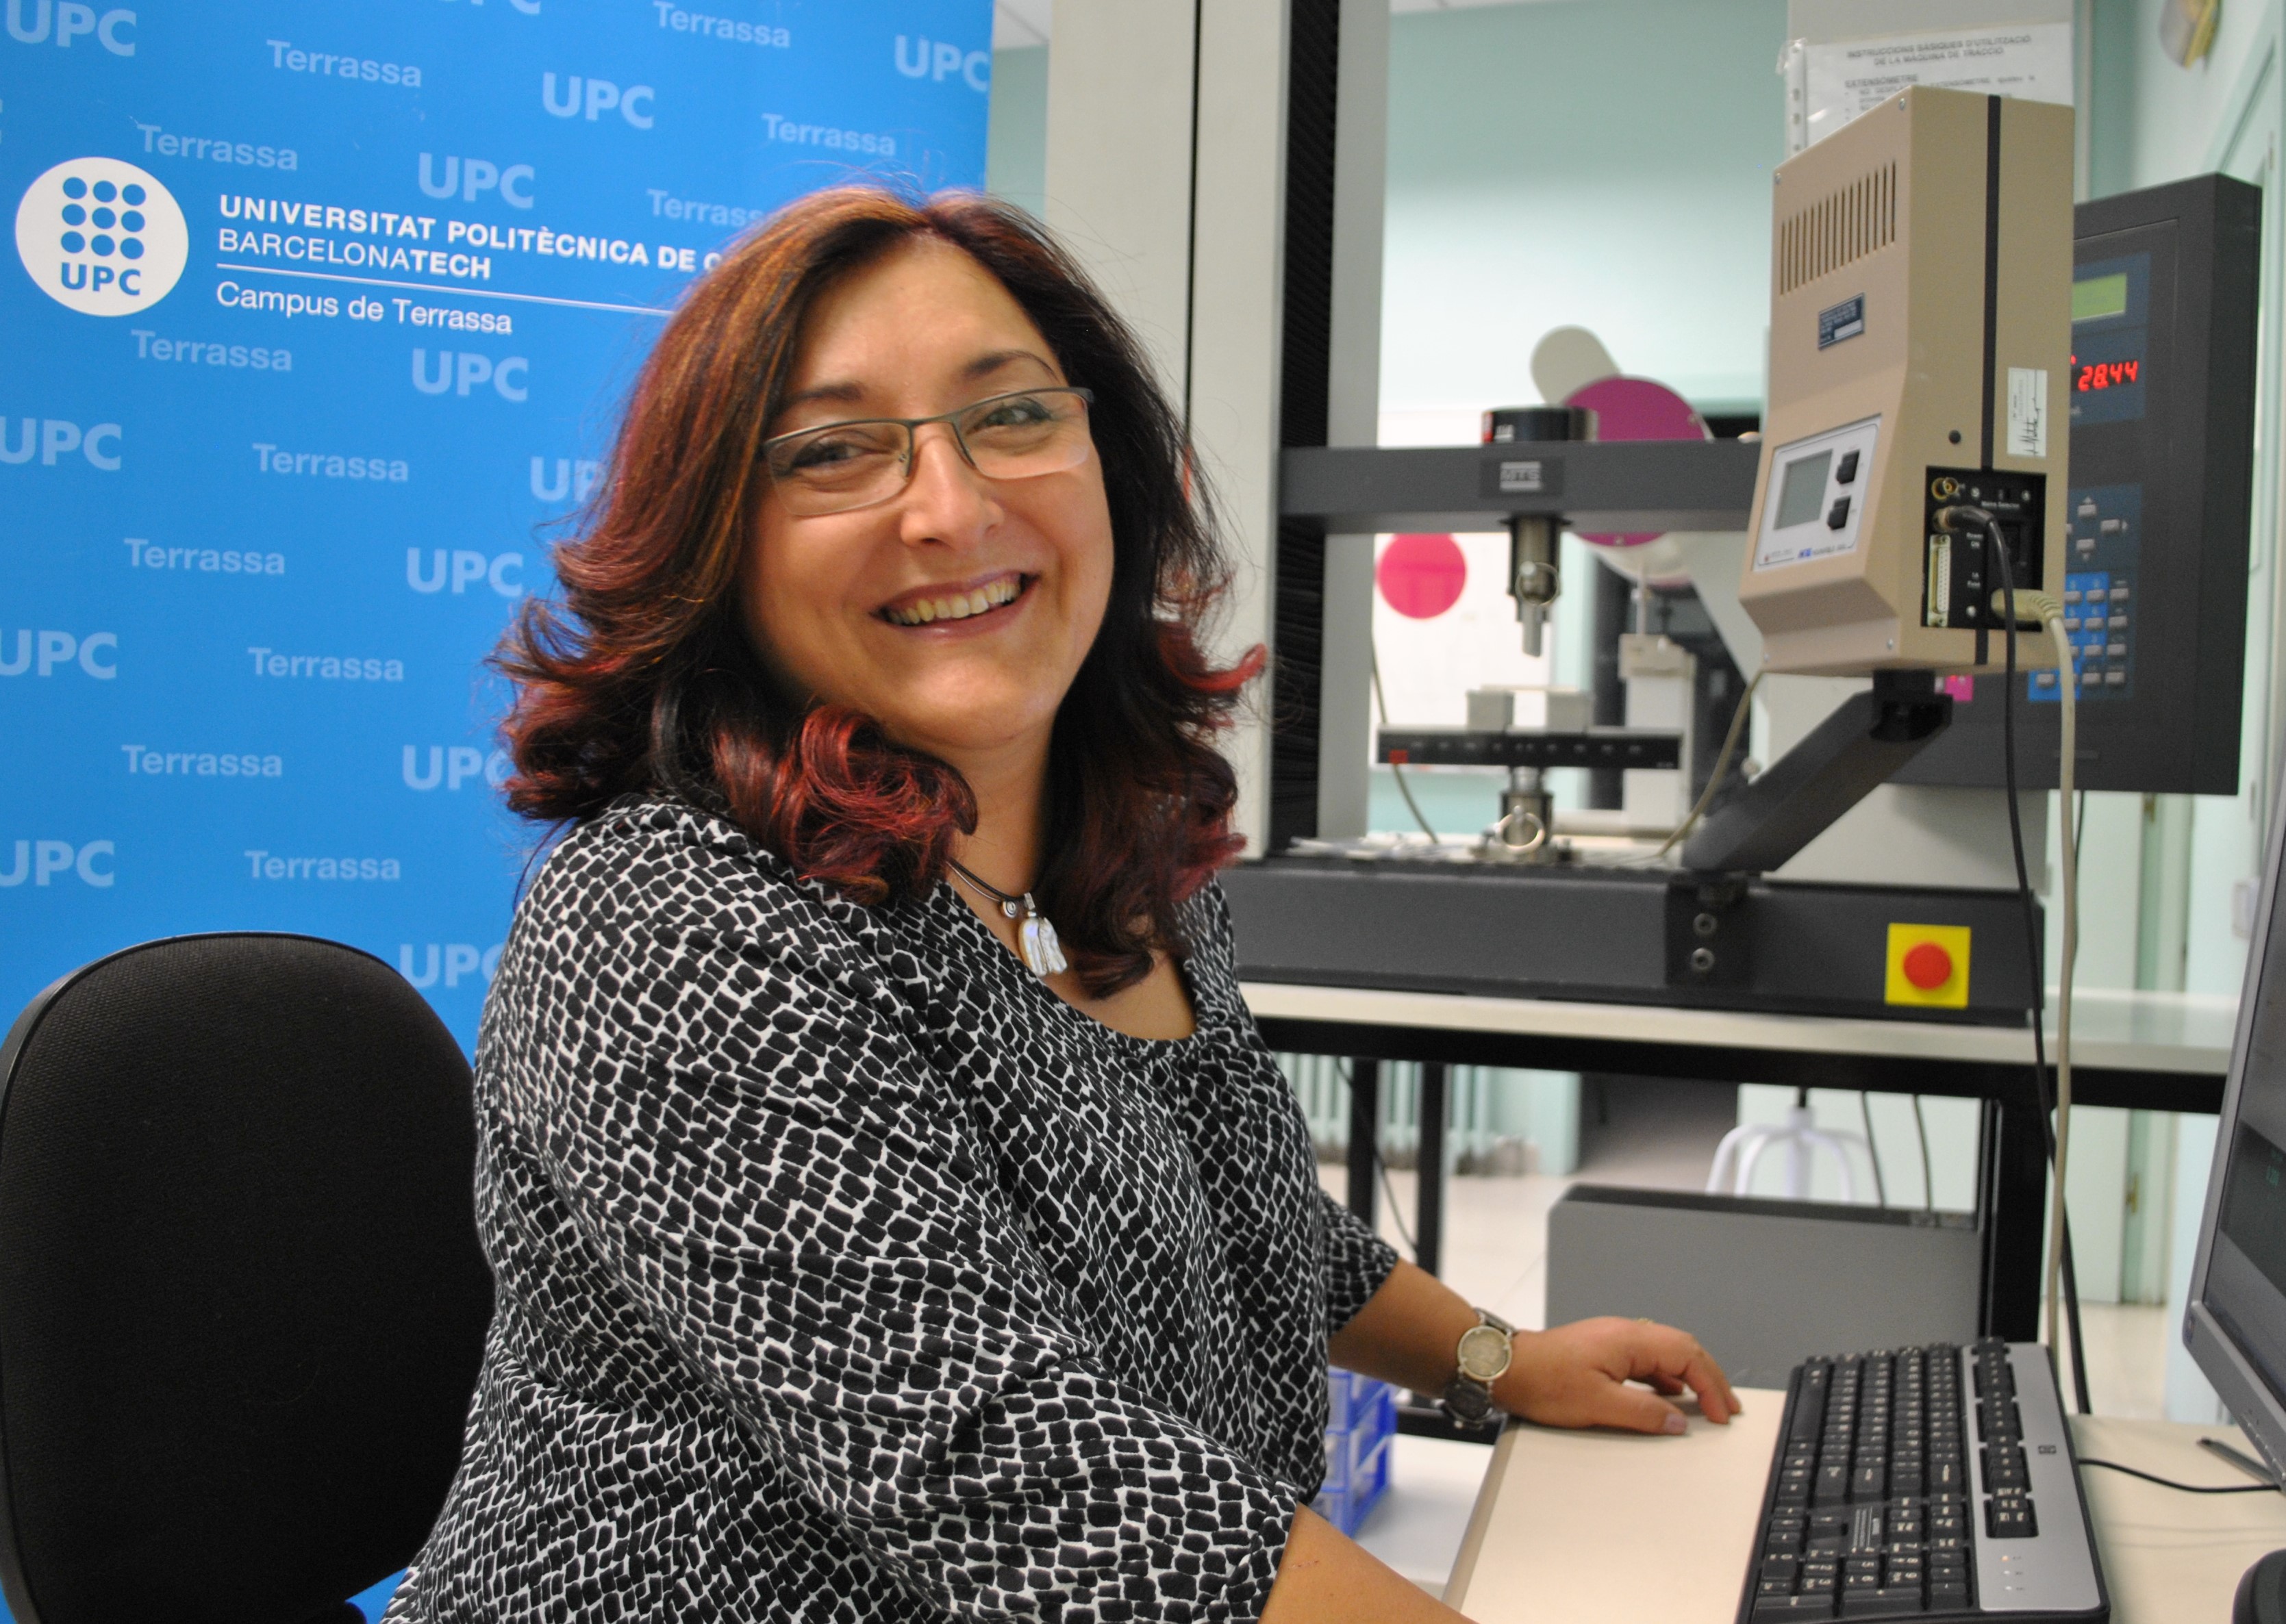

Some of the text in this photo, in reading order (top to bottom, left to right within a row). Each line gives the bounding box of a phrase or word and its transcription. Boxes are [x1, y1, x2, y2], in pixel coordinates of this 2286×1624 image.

[6, 0, 136, 56] UPC
[653, 1, 790, 47] Terrassa
[267, 40, 421, 87] Terrassa
[895, 35, 989, 91] UPC
[543, 72, 655, 129] UPC
[138, 124, 297, 171] Terrassa
[762, 113, 895, 156] Terrassa
[419, 153, 534, 209] UPC
[647, 188, 764, 227] Terras
[219, 228, 491, 280] BARCELONATECH
[220, 194, 436, 240] UNIVERSITAT
[448, 220, 649, 267] POLITÈCNICA
[658, 245, 696, 272] DE
[61, 262, 141, 296] UPC
[216, 281, 512, 334] Campus de Terrassa
[131, 329, 292, 372] Terrassa
[412, 348, 528, 402] UPC
[0, 416, 122, 471] UPC
[253, 443, 409, 482] Terrassa
[531, 456, 608, 501] UP
[124, 538, 285, 575] Terrassa
[407, 548, 523, 596] UPC
[0, 629, 117, 679] UPC
[248, 647, 403, 681] Terrassa
[122, 745, 282, 776] Terrassa
[0, 840, 114, 887] UPC
[244, 851, 400, 880] Terrassa
